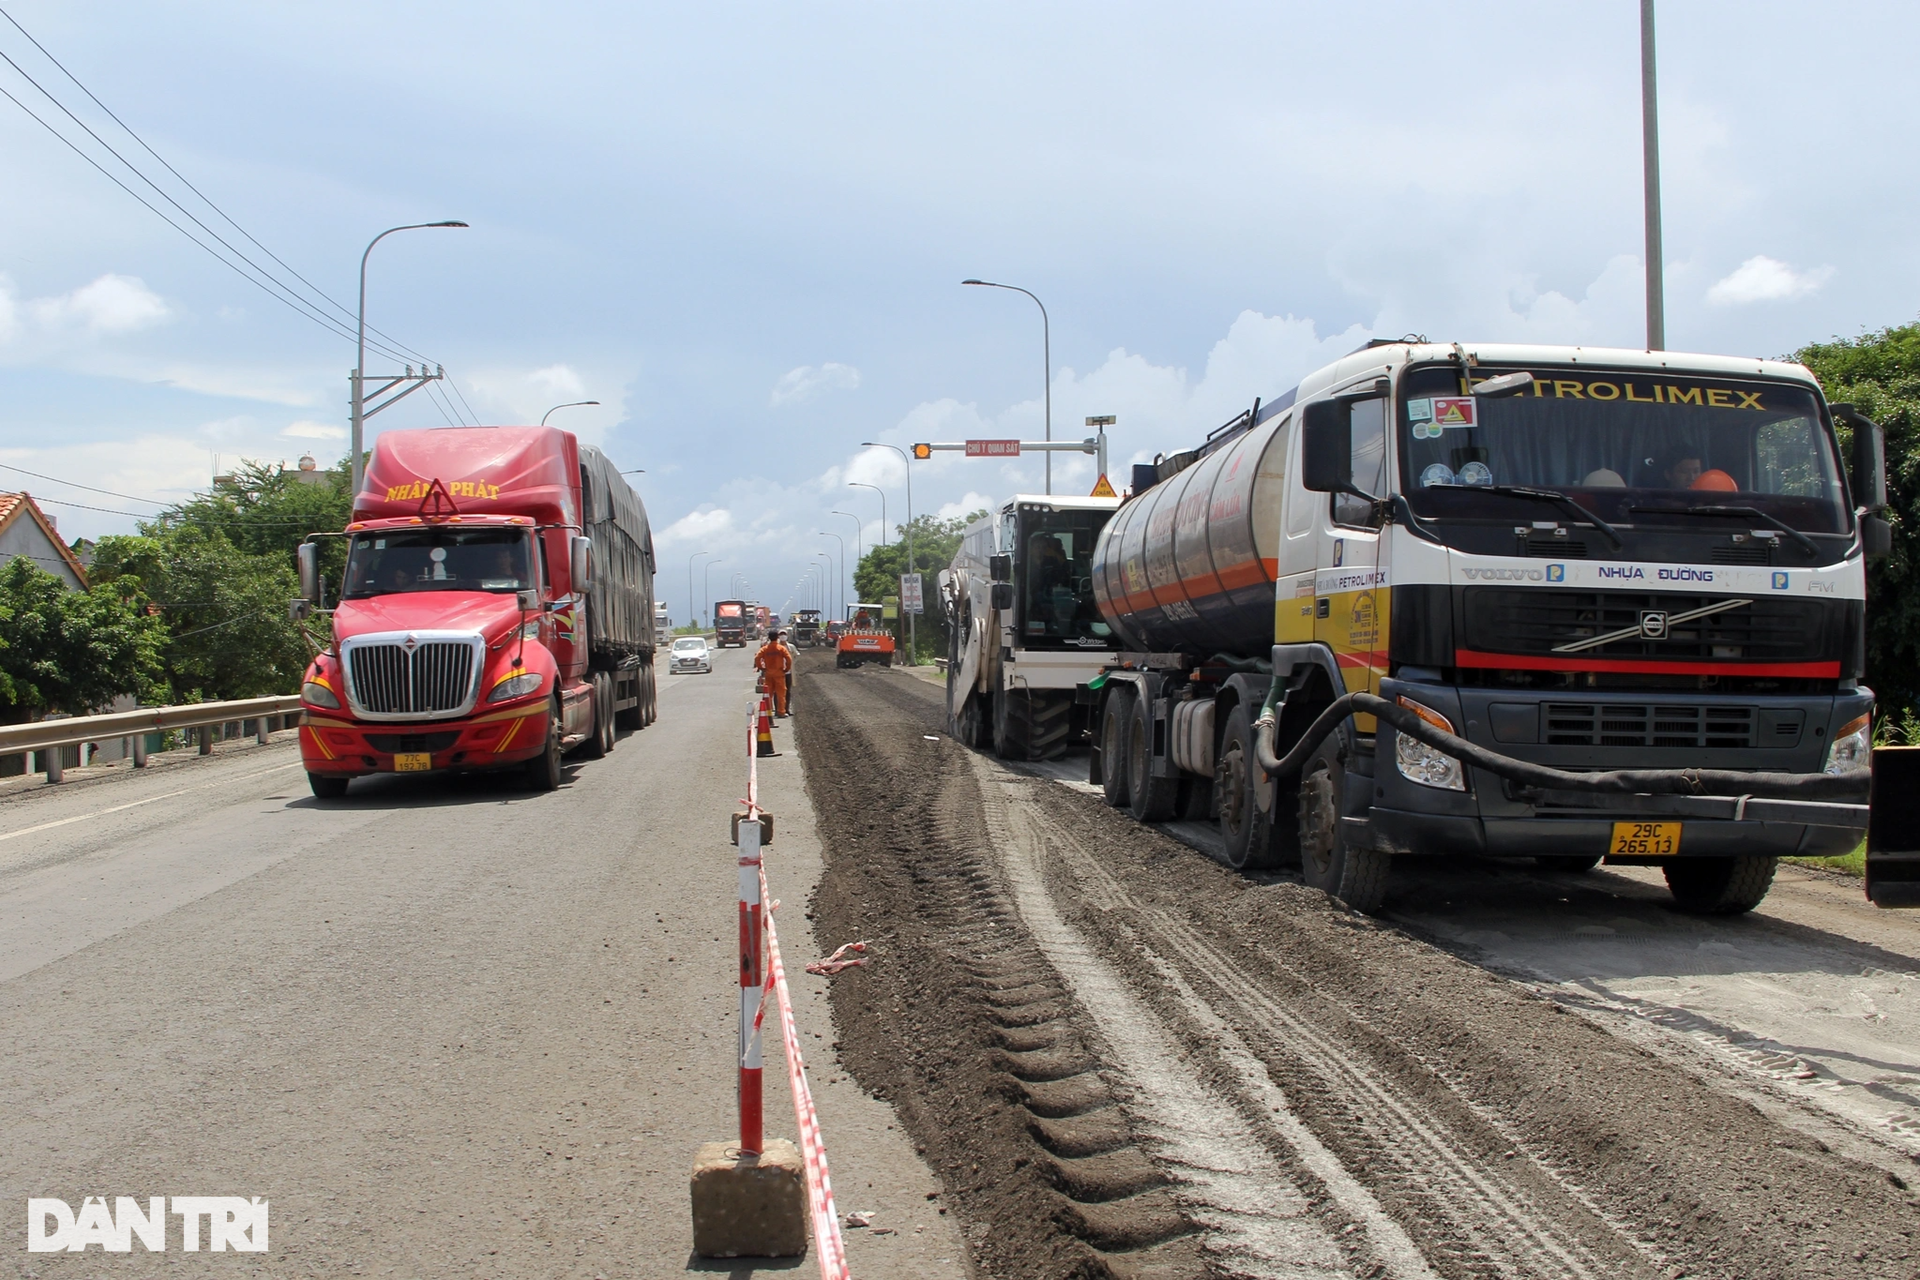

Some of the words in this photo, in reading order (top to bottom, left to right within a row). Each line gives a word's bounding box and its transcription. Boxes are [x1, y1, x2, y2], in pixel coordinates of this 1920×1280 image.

[1460, 377, 1766, 411] PTROLIMEX
[967, 442, 980, 454] CHÚ
[988, 443, 1005, 454] QUAN
[1006, 442, 1019, 454] SÁT
[1339, 572, 1386, 589] PETROLIMEX
[1461, 568, 1544, 581] VOLVO
[1599, 566, 1644, 581] NHỰA
[1658, 566, 1713, 582] ĐƯỜNG
[1808, 580, 1835, 593] FM
[1632, 824, 1662, 838] 29C
[1617, 840, 1672, 853] 265.13
